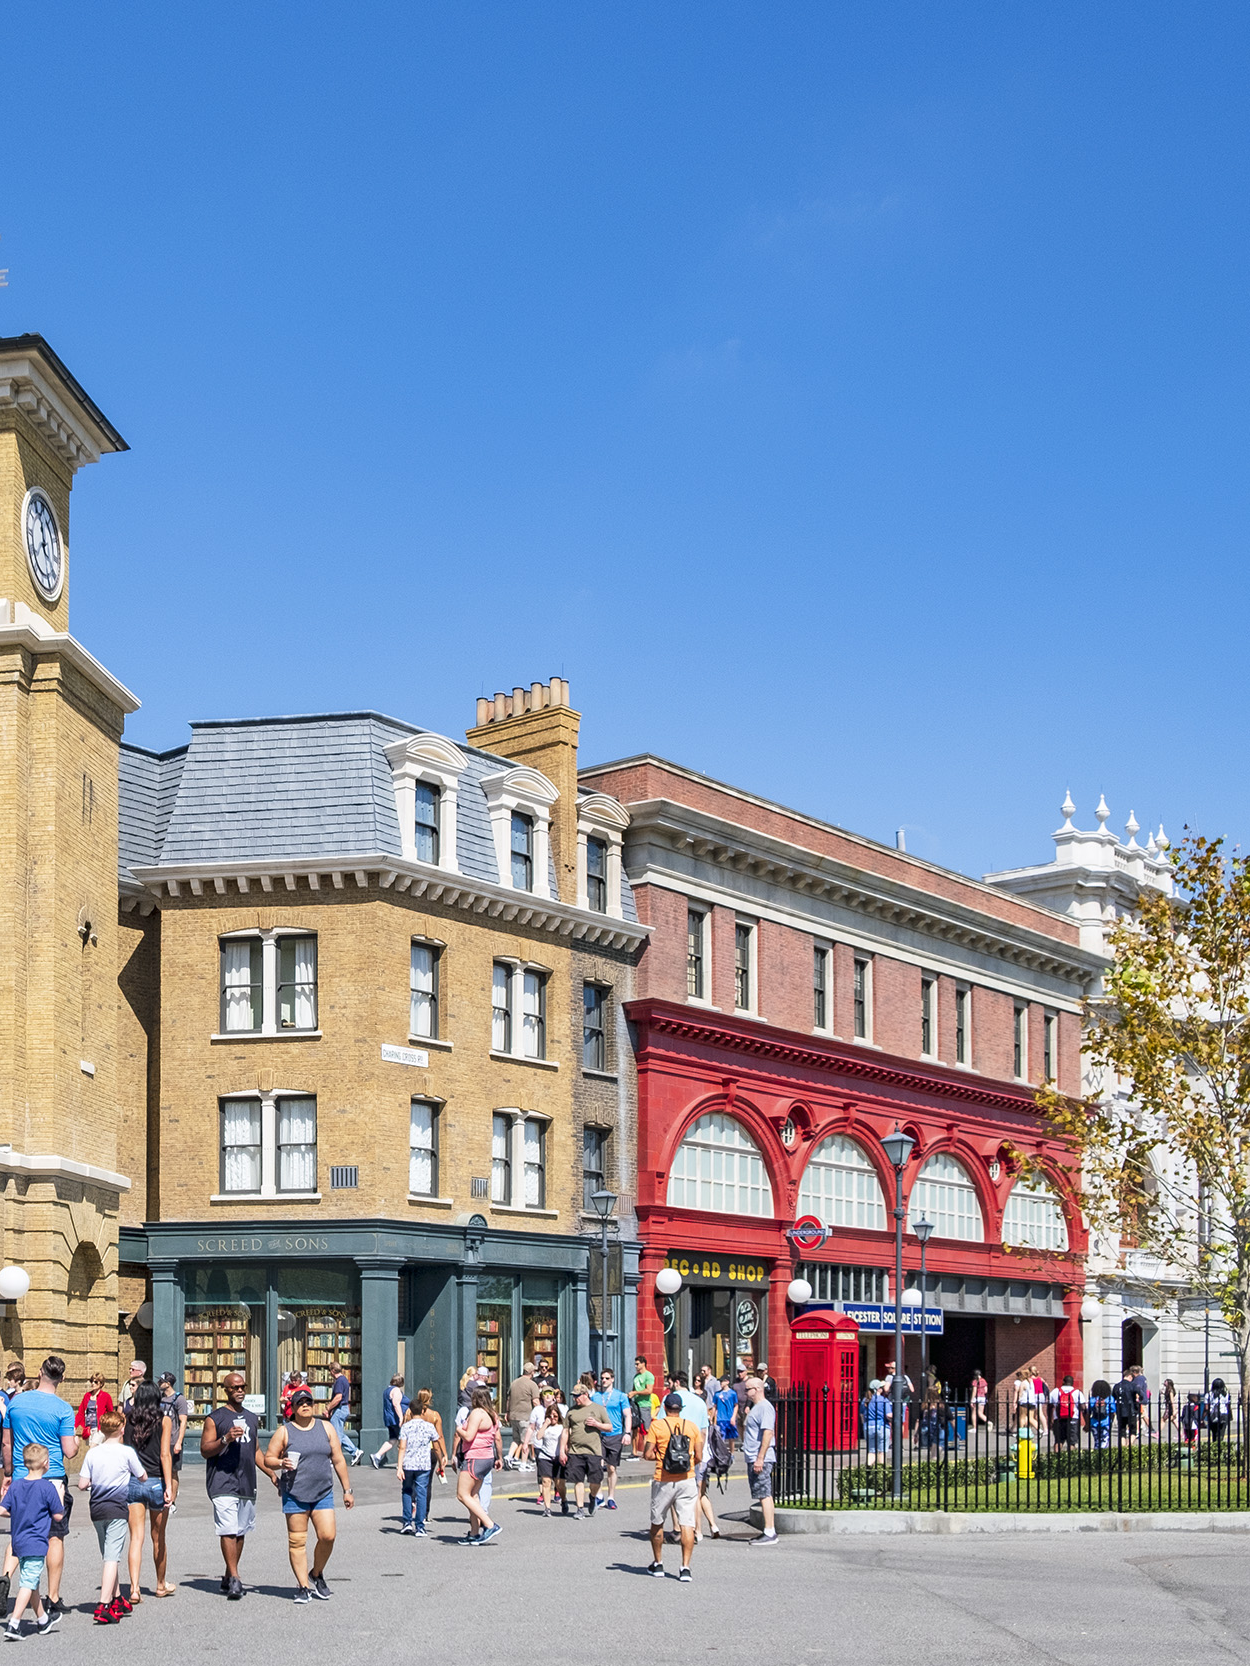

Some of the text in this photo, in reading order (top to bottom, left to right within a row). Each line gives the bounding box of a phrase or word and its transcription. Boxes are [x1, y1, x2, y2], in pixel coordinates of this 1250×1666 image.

[197, 1238, 263, 1251] SCREED
[285, 1237, 329, 1250] SONS
[728, 1263, 764, 1282] SHOP
[198, 1309, 226, 1320] SCREED
[234, 1309, 252, 1319] SONS
[328, 1309, 347, 1319] SONS
[883, 1312, 912, 1324] SQURE
[913, 1313, 942, 1326] STTION
